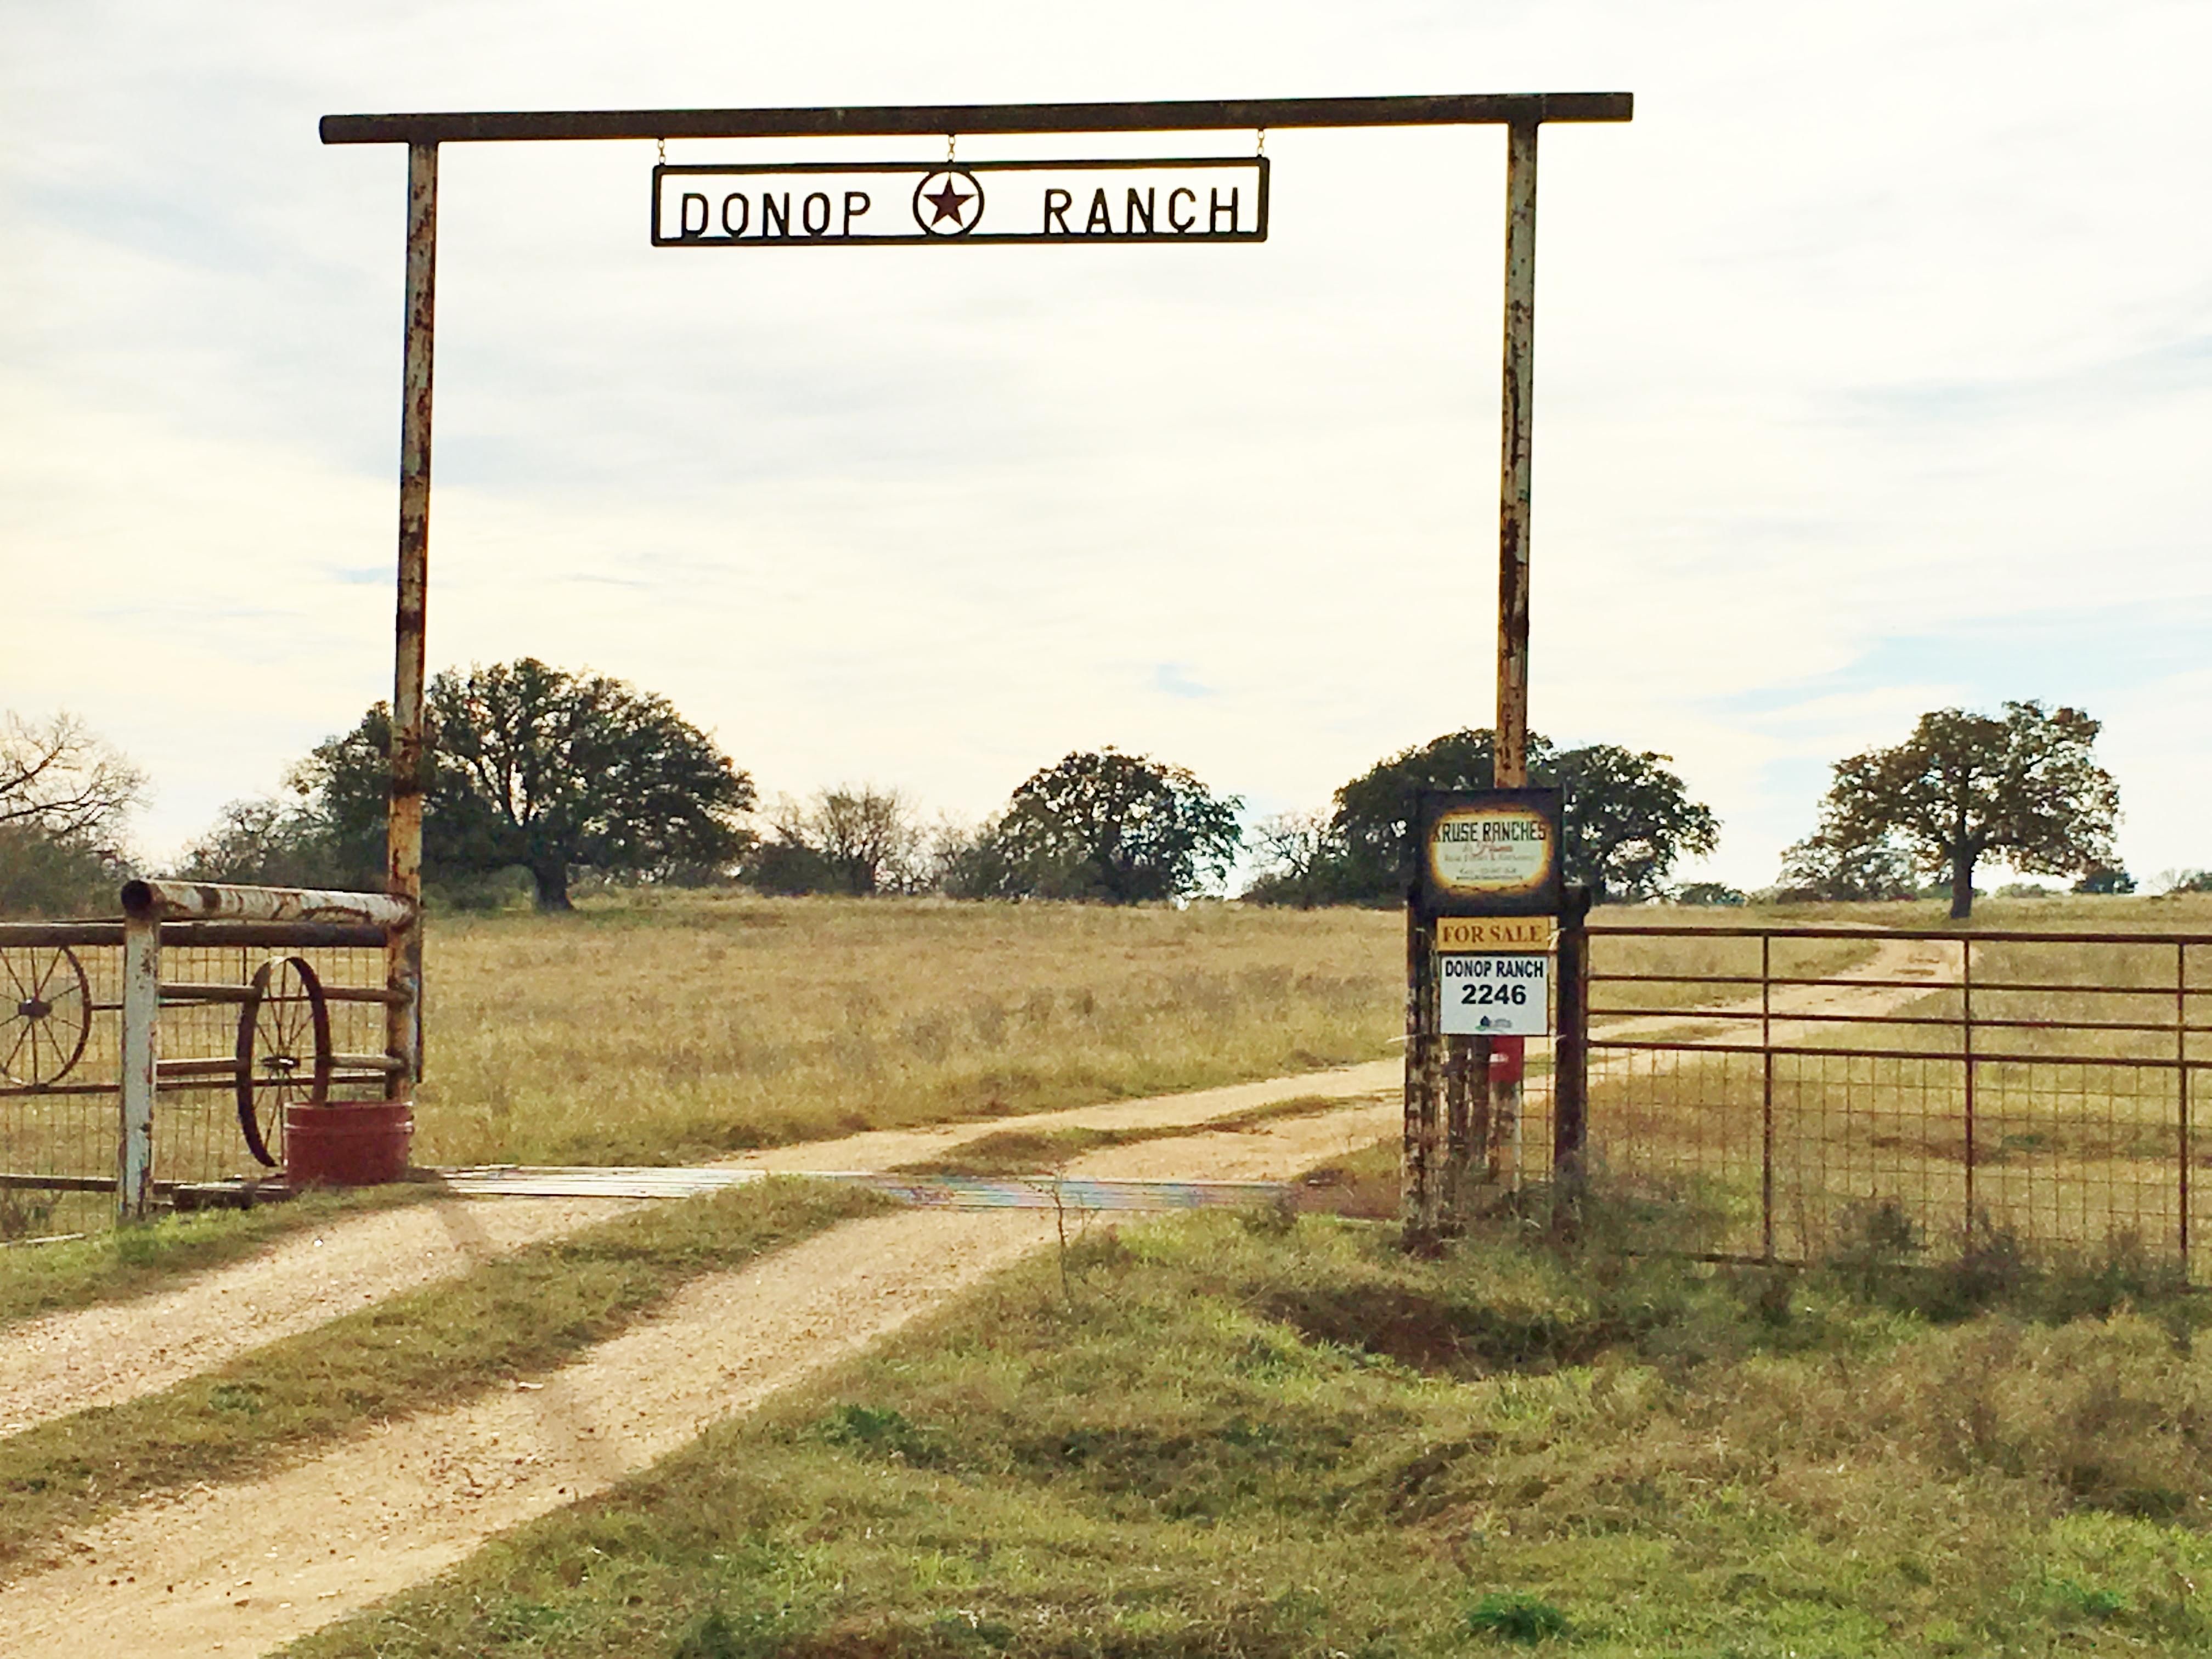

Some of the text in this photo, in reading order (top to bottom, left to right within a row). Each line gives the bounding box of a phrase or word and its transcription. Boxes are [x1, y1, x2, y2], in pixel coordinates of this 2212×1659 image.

[681, 187, 1238, 238] DONOP RANCH
[1432, 821, 1546, 842] KRUSE RANCHES
[1443, 924, 1543, 943] FOR SALE
[1446, 961, 1543, 978] DONOP RANCH
[1461, 984, 1526, 1005] 2246
